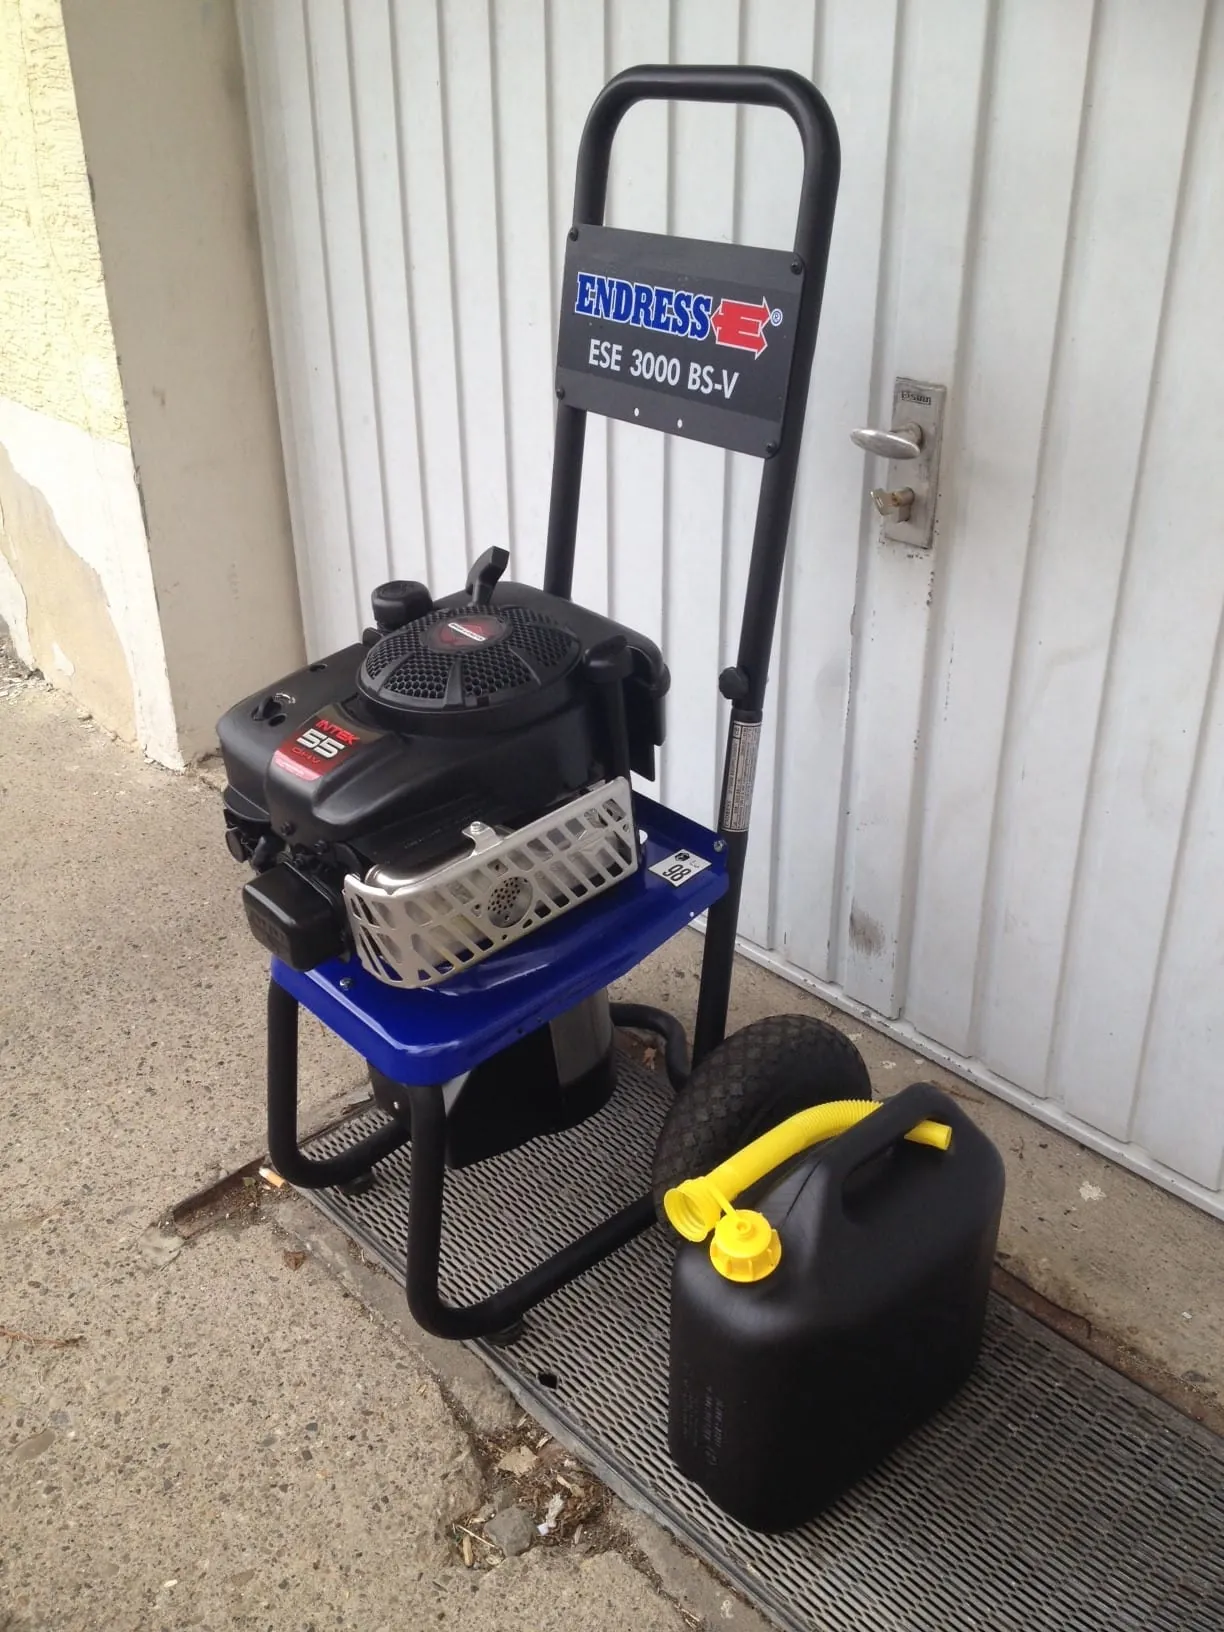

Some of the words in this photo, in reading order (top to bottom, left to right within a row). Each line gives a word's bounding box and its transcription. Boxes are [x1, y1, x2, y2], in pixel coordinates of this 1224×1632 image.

[574, 271, 713, 340] ENDRESS
[588, 338, 623, 372] ESE
[630, 348, 681, 386] 3000
[687, 362, 740, 400] BS-V
[296, 728, 345, 759] 55
[316, 719, 361, 745] INTEK
[291, 746, 321, 764] OHV
[662, 864, 692, 882] 98
